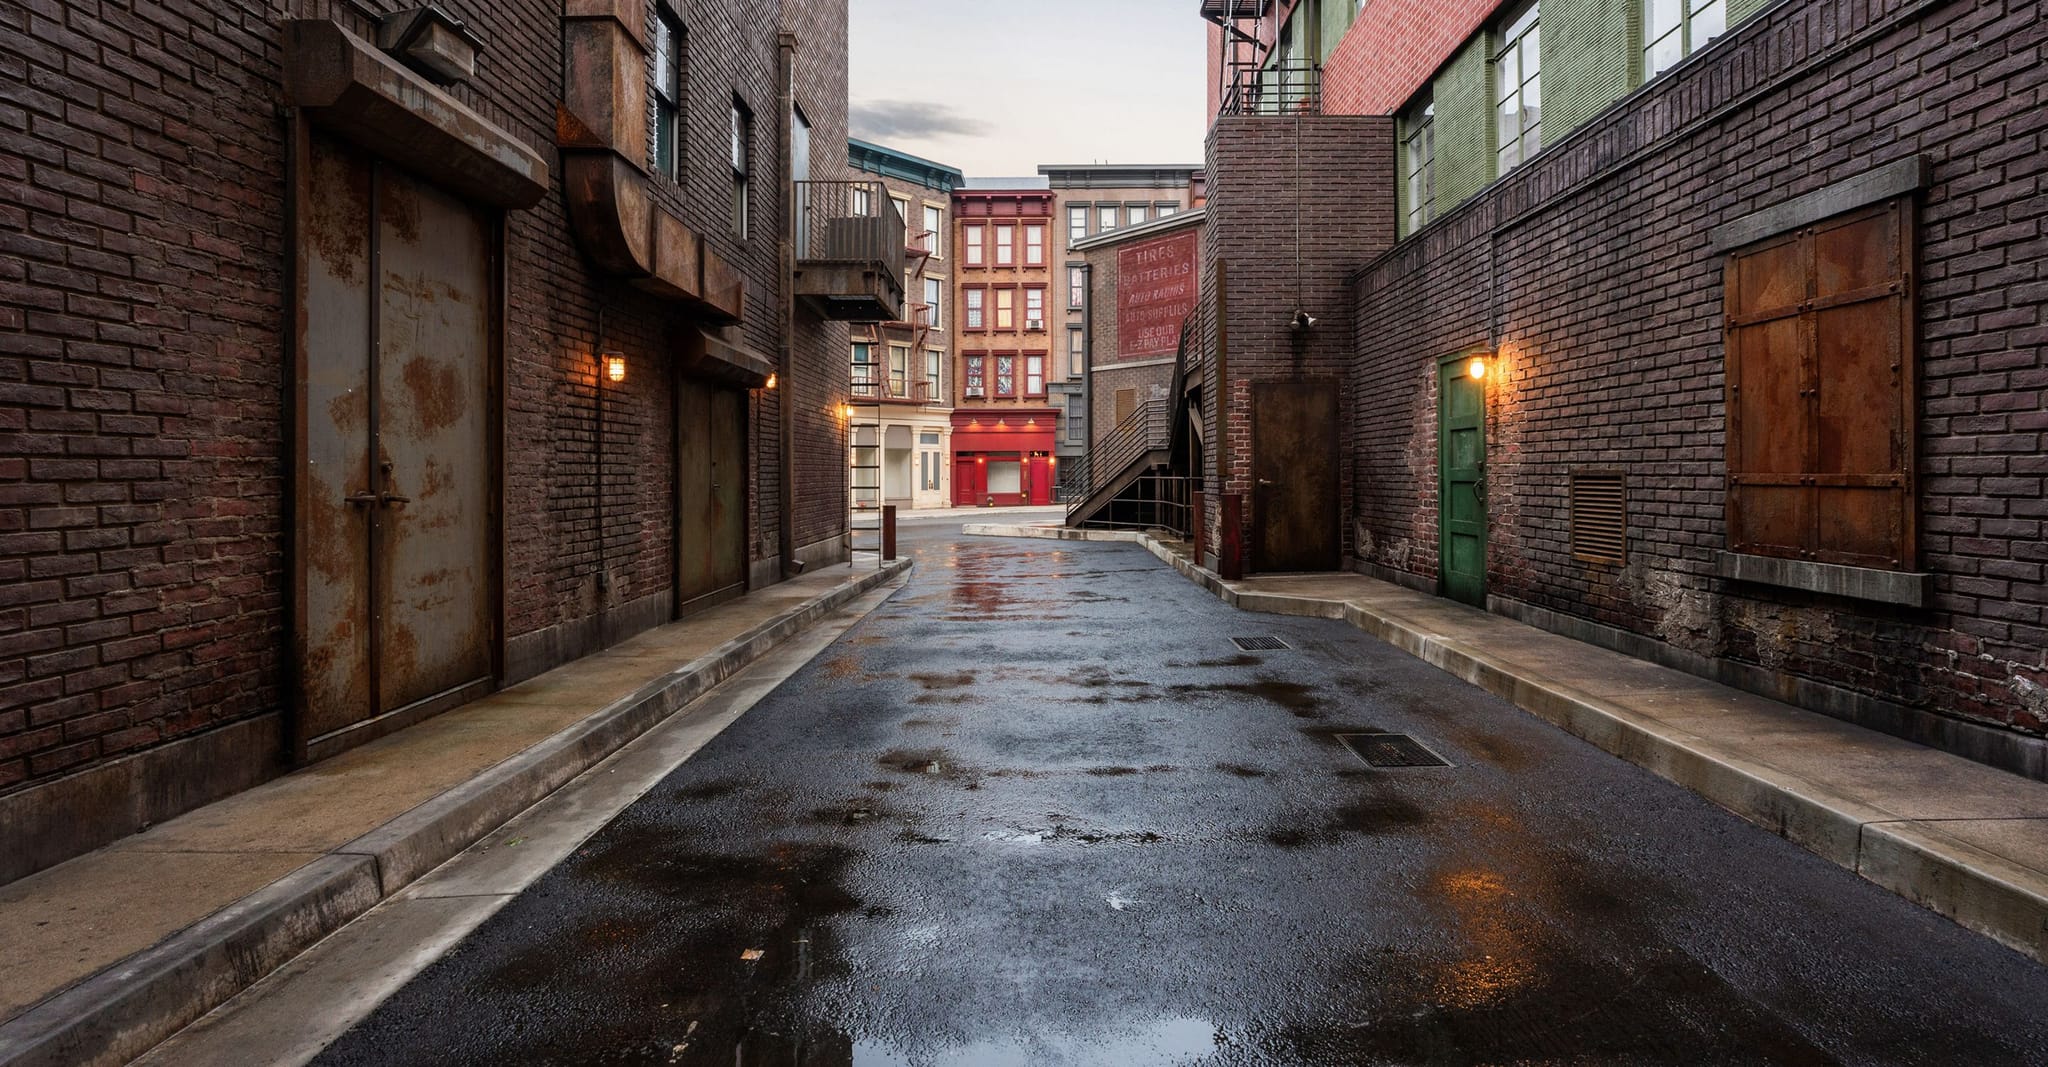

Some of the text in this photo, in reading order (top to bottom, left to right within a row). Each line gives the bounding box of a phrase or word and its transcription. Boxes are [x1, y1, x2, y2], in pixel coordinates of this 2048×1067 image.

[1136, 245, 1174, 264] TIRES
[1123, 262, 1190, 287] BATTERIES
[1128, 291, 1151, 305] AUTO
[1138, 324, 1175, 339] USE OUR
[1144, 336, 1160, 349] PAY
